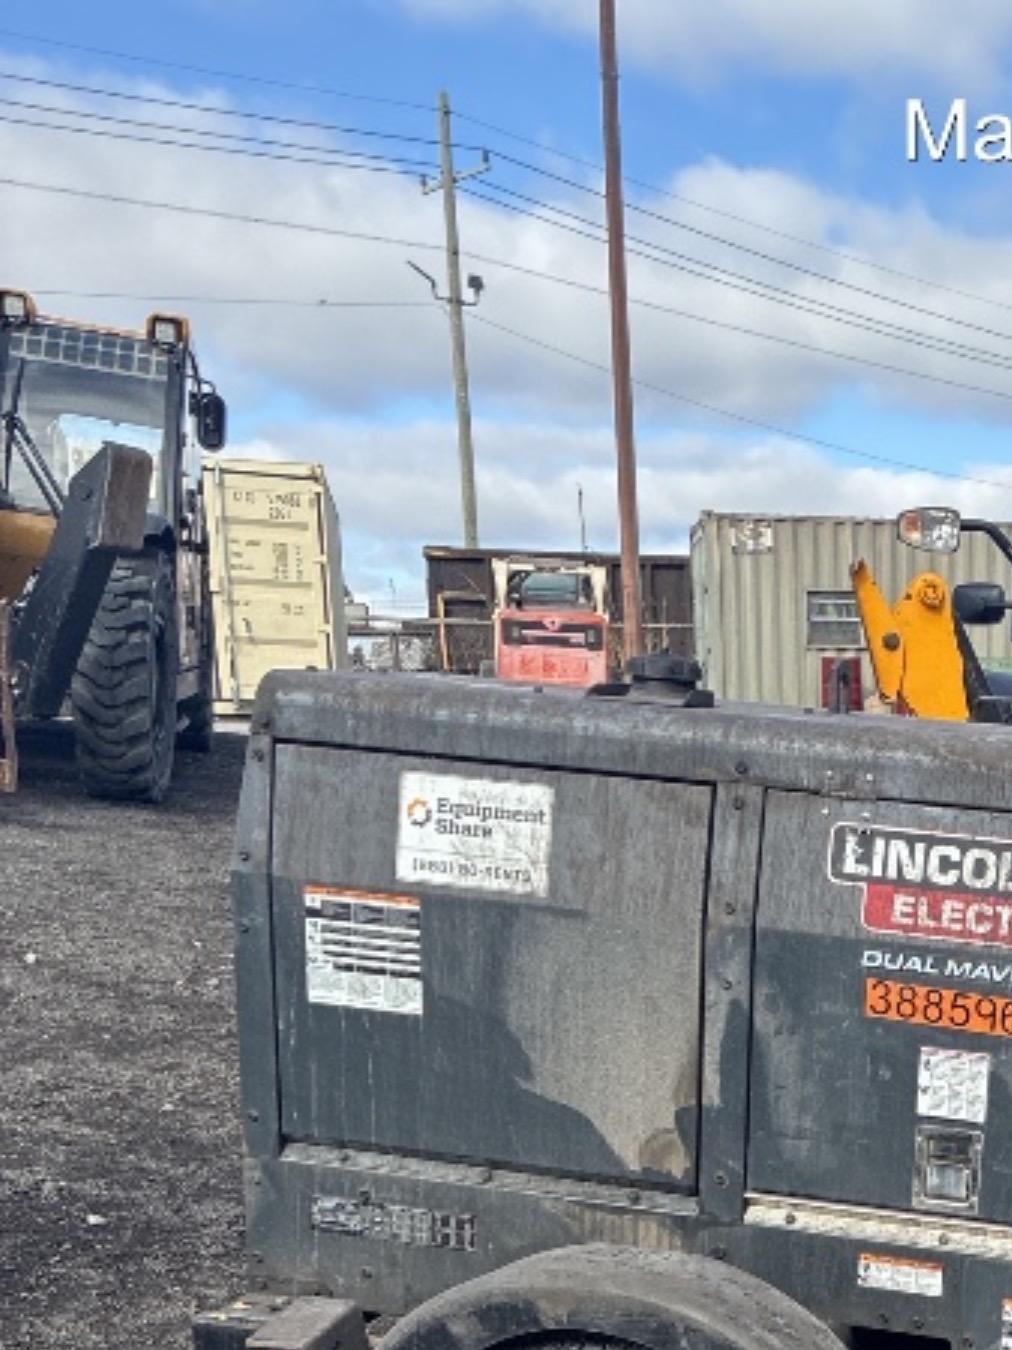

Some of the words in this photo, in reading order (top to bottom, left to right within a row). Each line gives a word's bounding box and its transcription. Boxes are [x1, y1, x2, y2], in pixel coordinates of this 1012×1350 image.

[436, 797, 547, 825] Equipment
[433, 818, 493, 838] Share
[860, 950, 939, 975] DUAL
